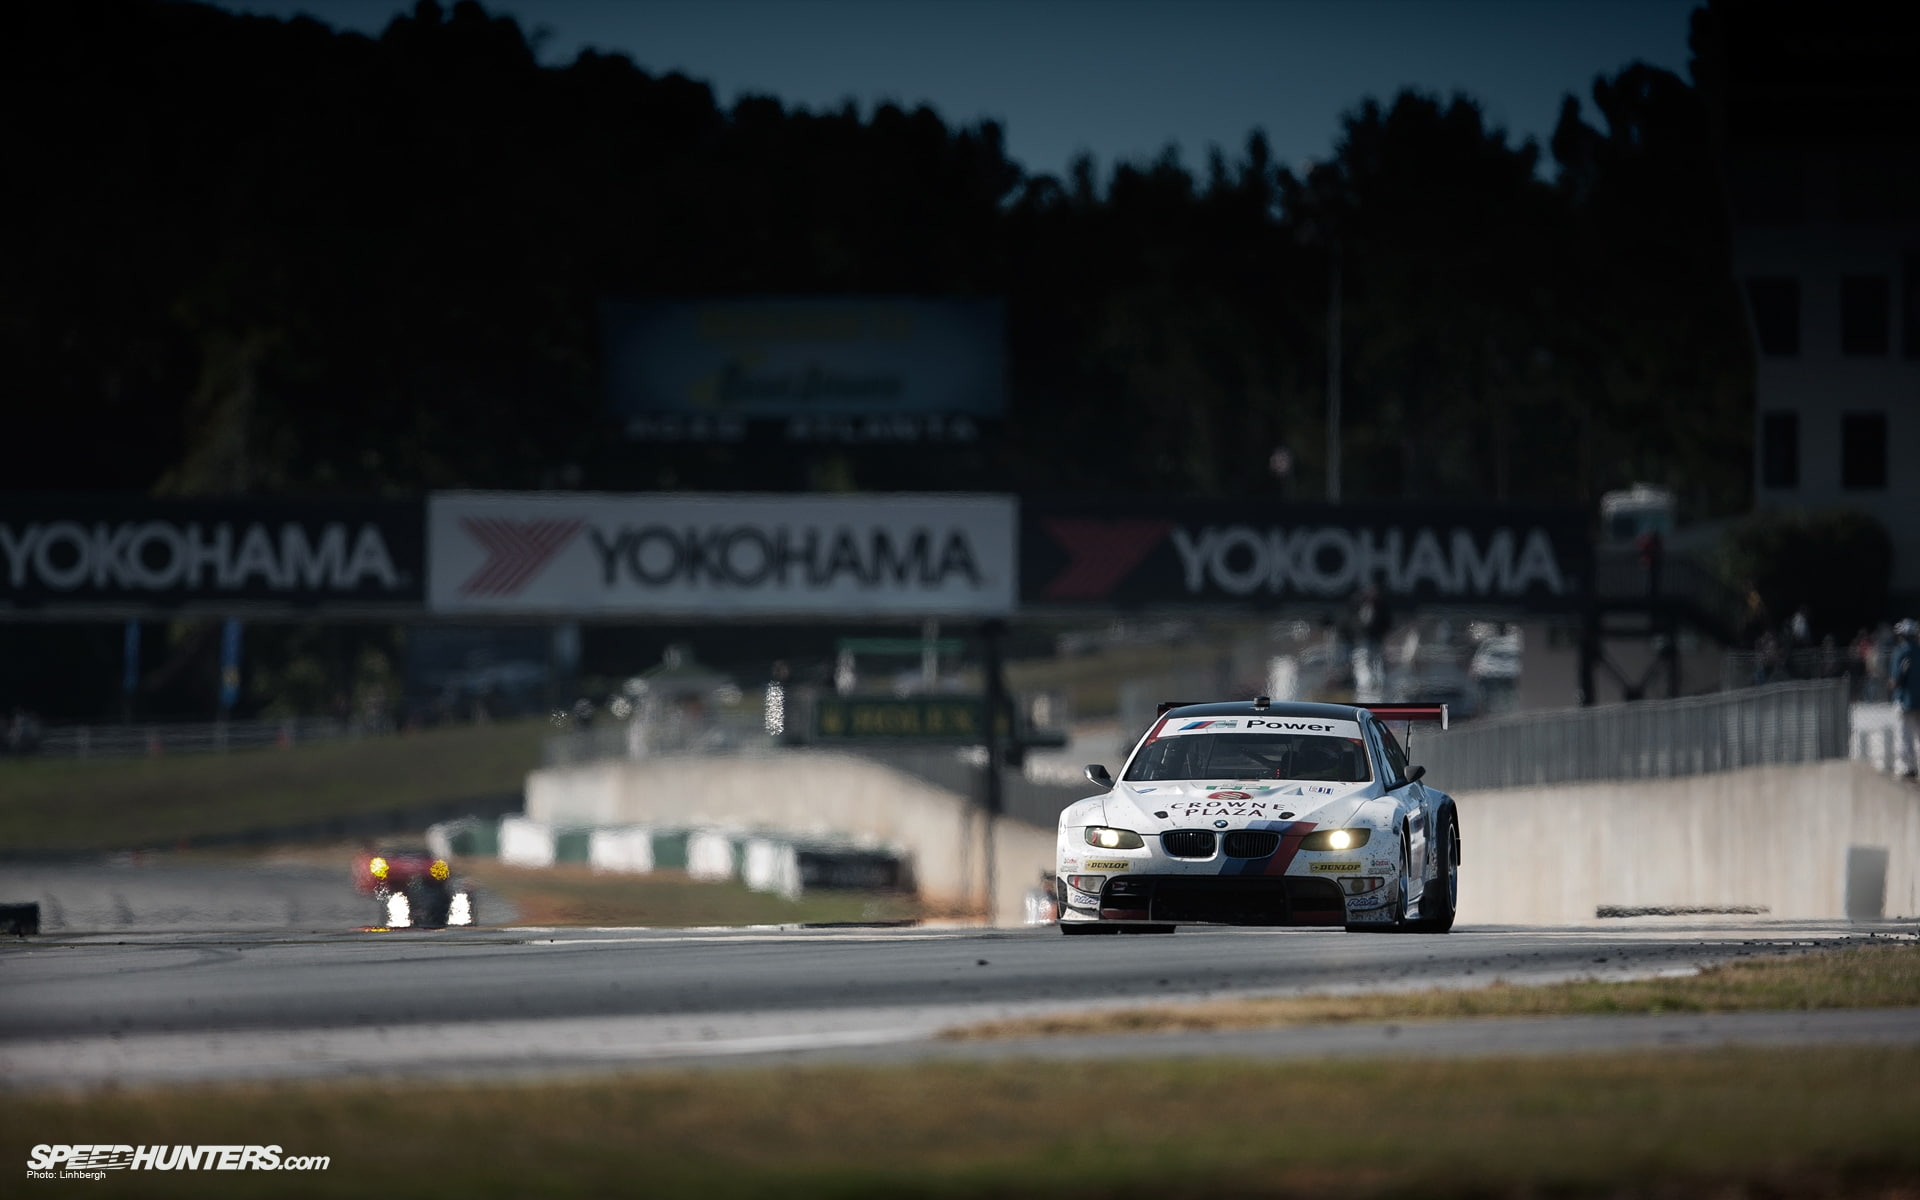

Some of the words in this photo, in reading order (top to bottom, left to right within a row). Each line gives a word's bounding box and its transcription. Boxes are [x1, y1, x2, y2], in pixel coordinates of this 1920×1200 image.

[0, 520, 399, 592] YOKOHAMA
[590, 524, 982, 588] YOKOHAMA
[1171, 526, 1564, 595] YOKOHAMA
[1246, 719, 1335, 732] Power
[1171, 801, 1285, 810] CROWNE
[1185, 808, 1263, 817] PLAZA
